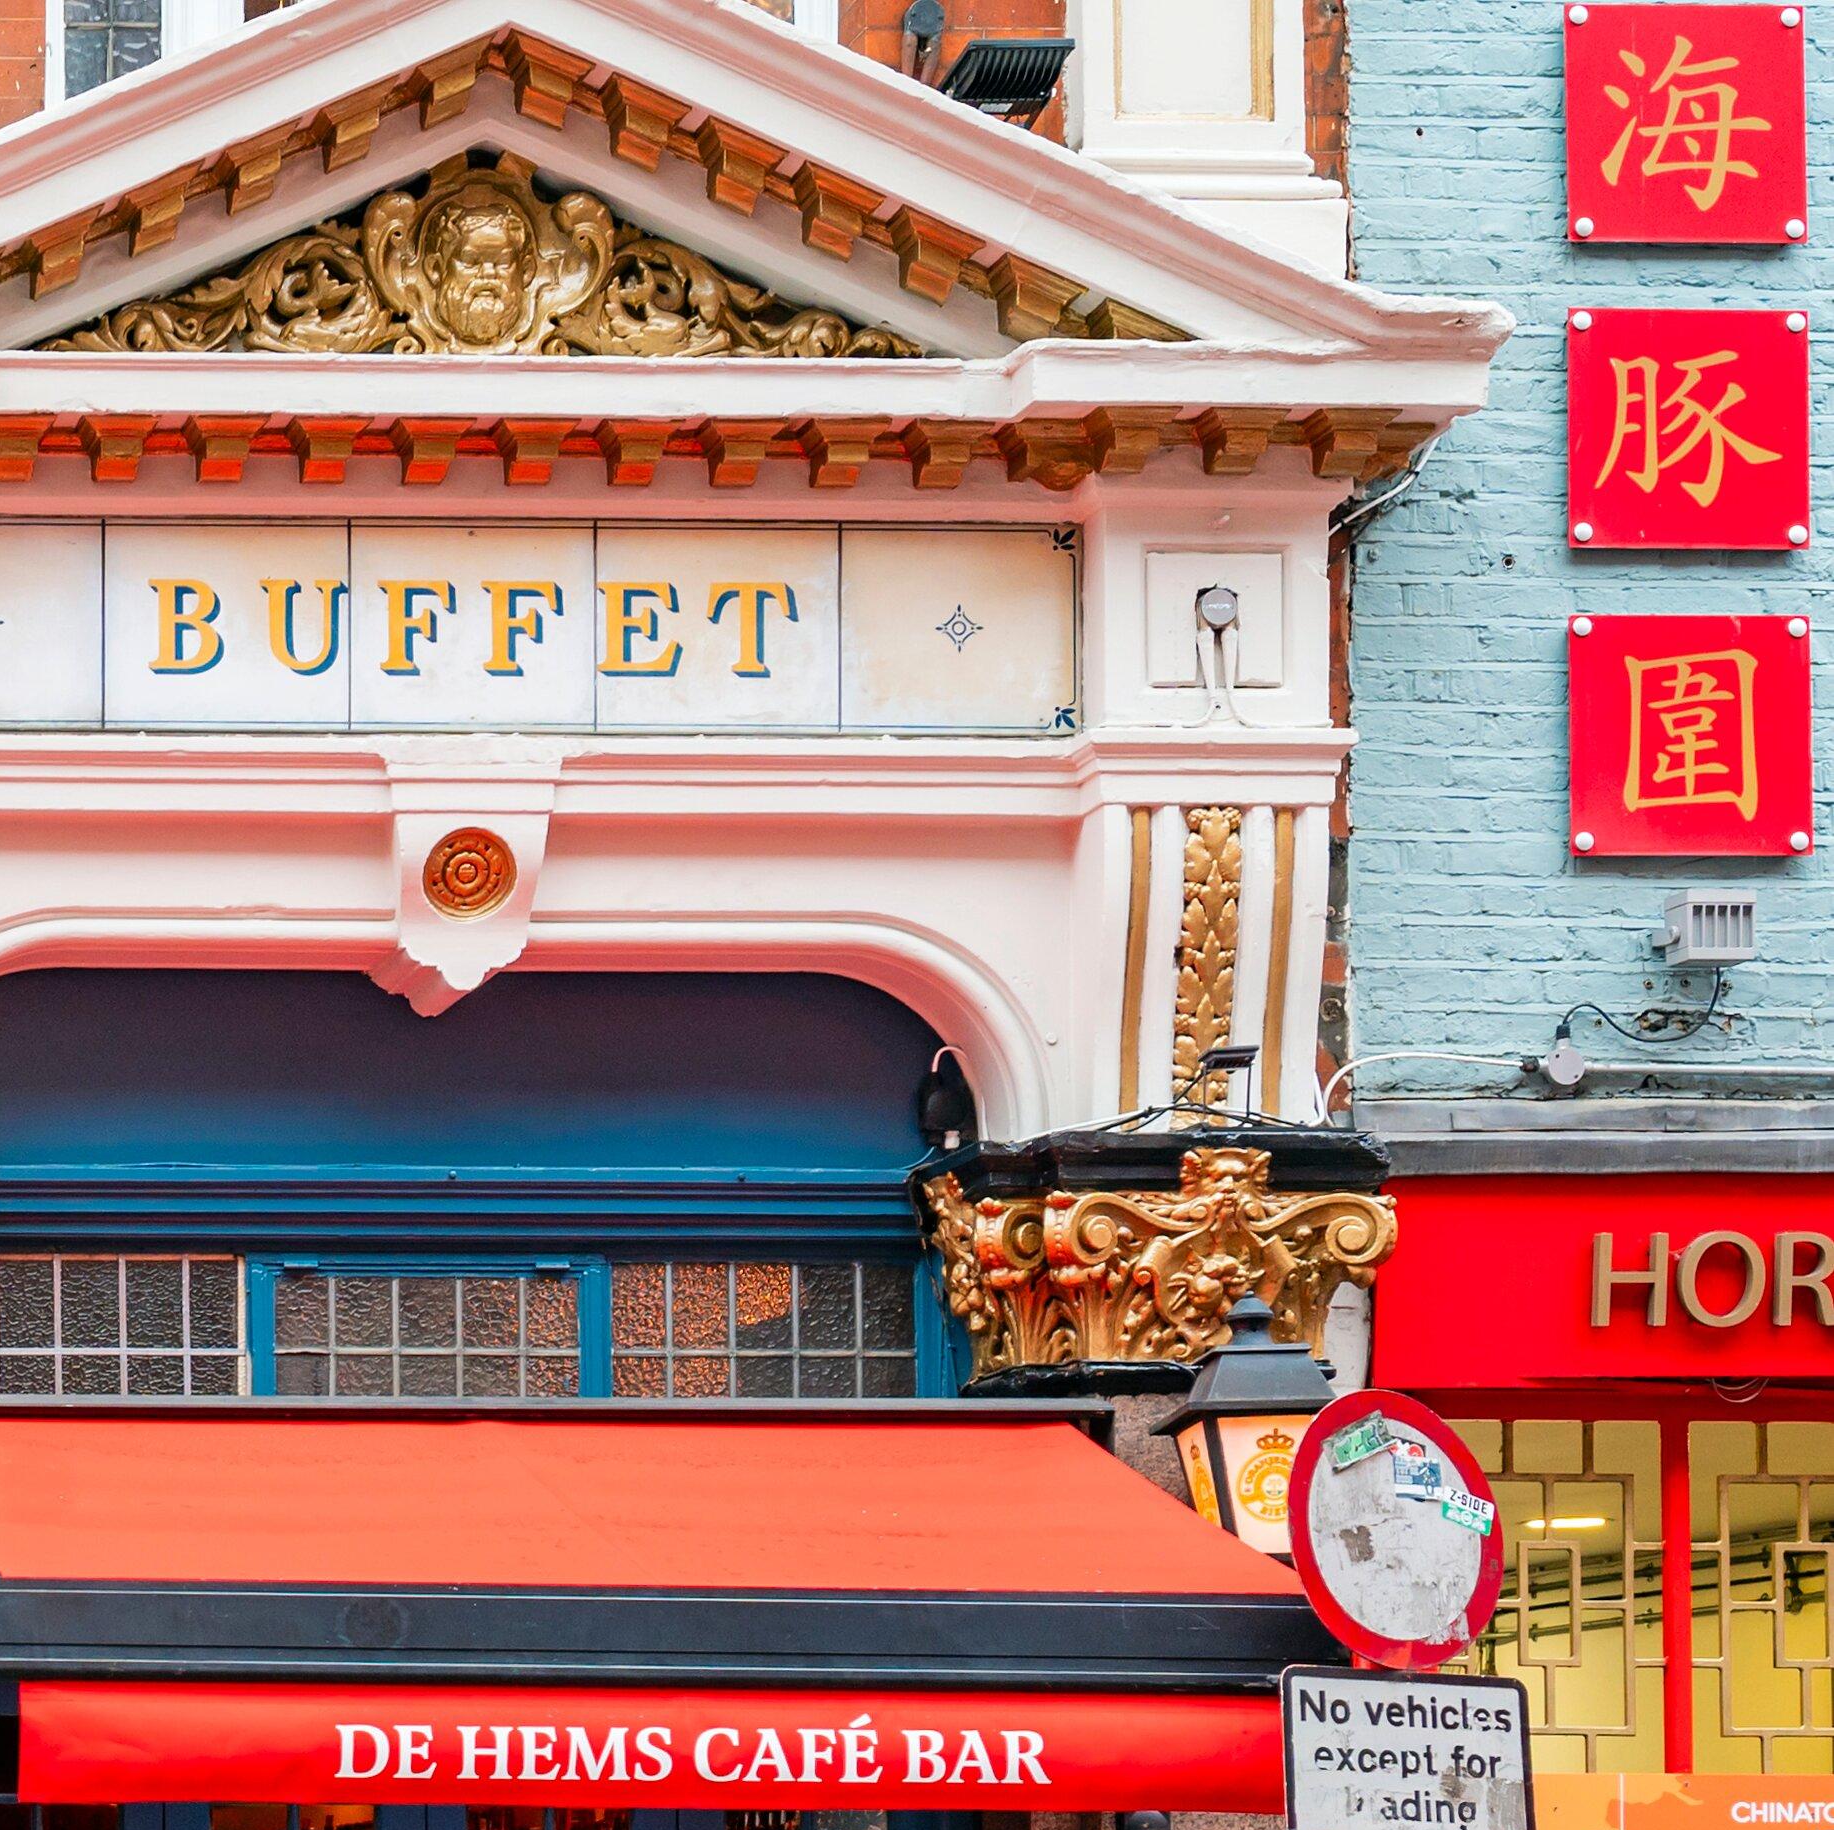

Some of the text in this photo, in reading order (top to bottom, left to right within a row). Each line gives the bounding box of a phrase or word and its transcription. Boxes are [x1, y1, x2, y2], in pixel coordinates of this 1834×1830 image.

[148, 577, 798, 679] BUFFET
[1450, 1489, 1488, 1515] Z-SIDE
[1299, 1689, 1512, 1733] No vehicles
[334, 1712, 1052, 1785] DE HEMS CAFÉ BAR
[1314, 1744, 1502, 1779] except for
